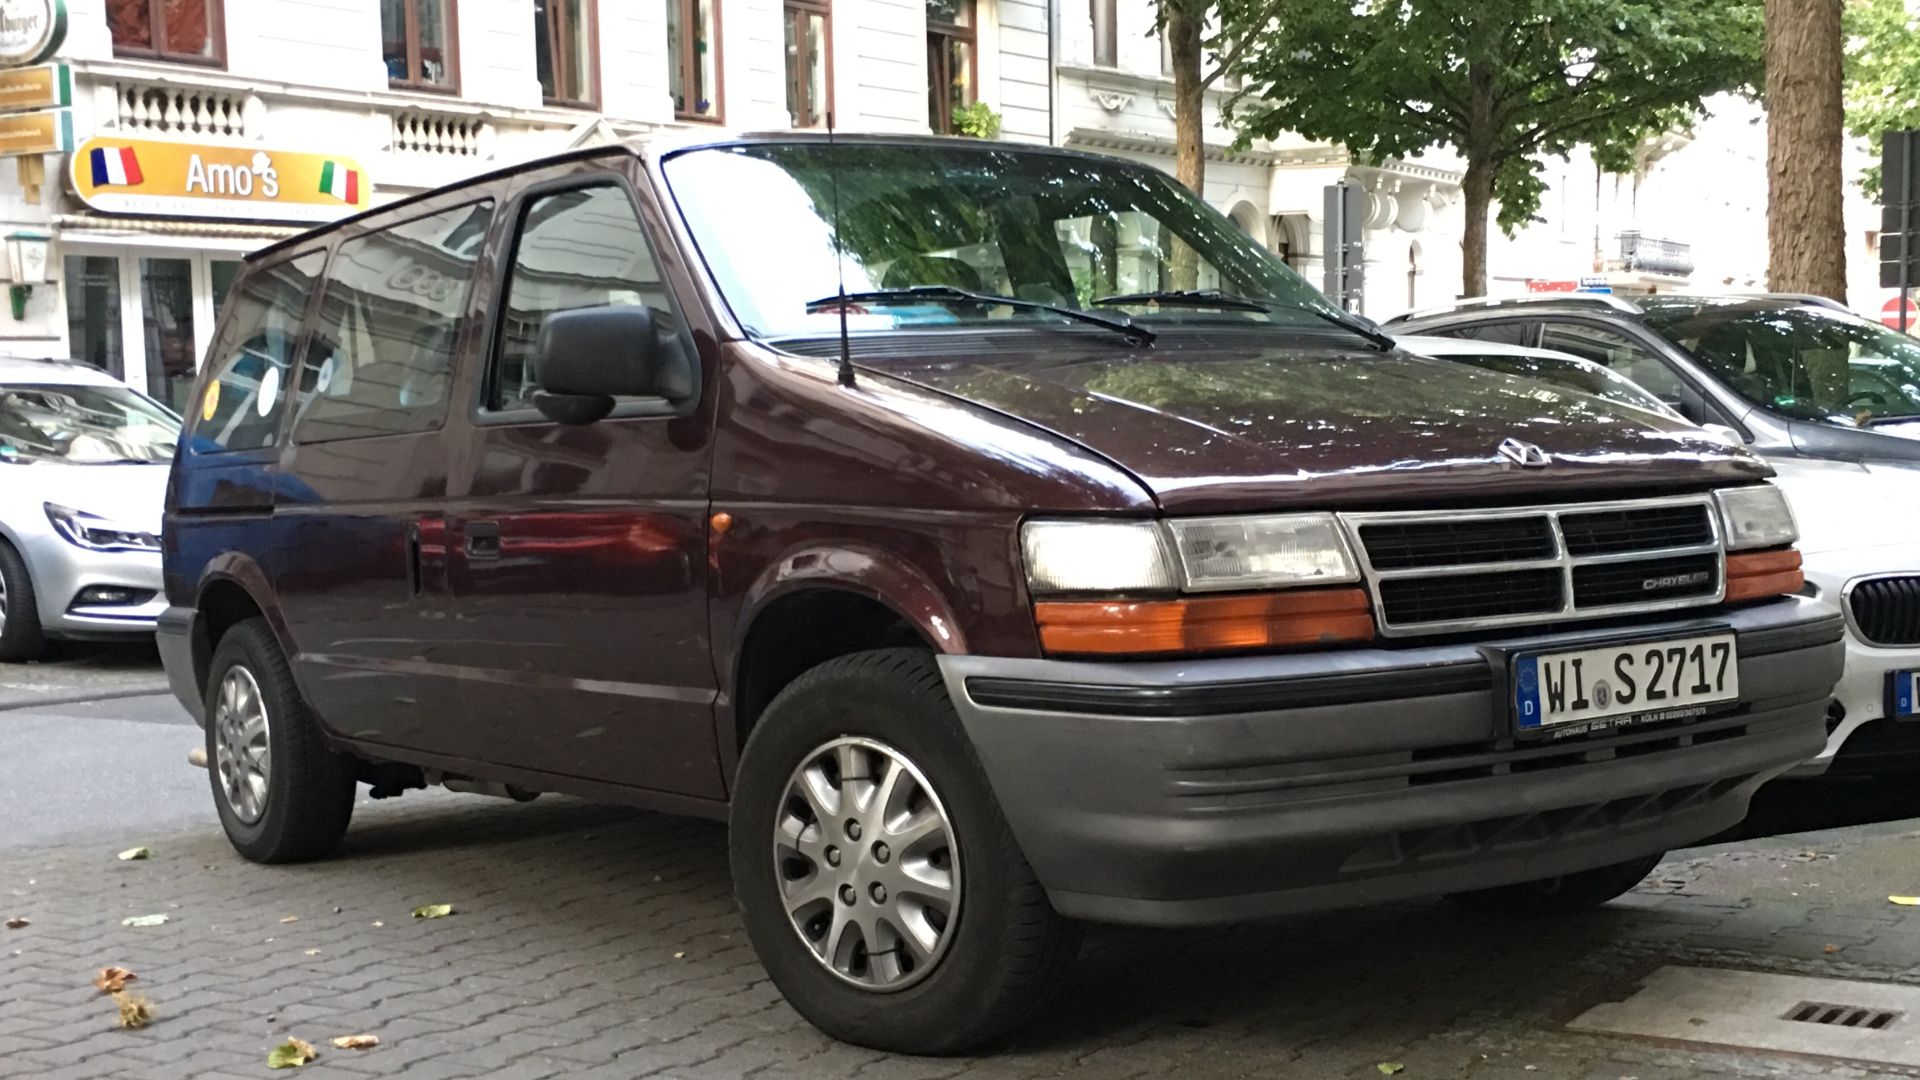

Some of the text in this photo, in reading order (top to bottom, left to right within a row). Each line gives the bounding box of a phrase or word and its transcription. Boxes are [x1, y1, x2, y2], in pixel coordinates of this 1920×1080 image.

[186, 152, 279, 197] Amo's
[1643, 571, 1709, 590] CHRYSLER
[1544, 657, 1589, 714] WI
[1524, 700, 1533, 716] D
[1554, 723, 1588, 738] AUTOHAUS
